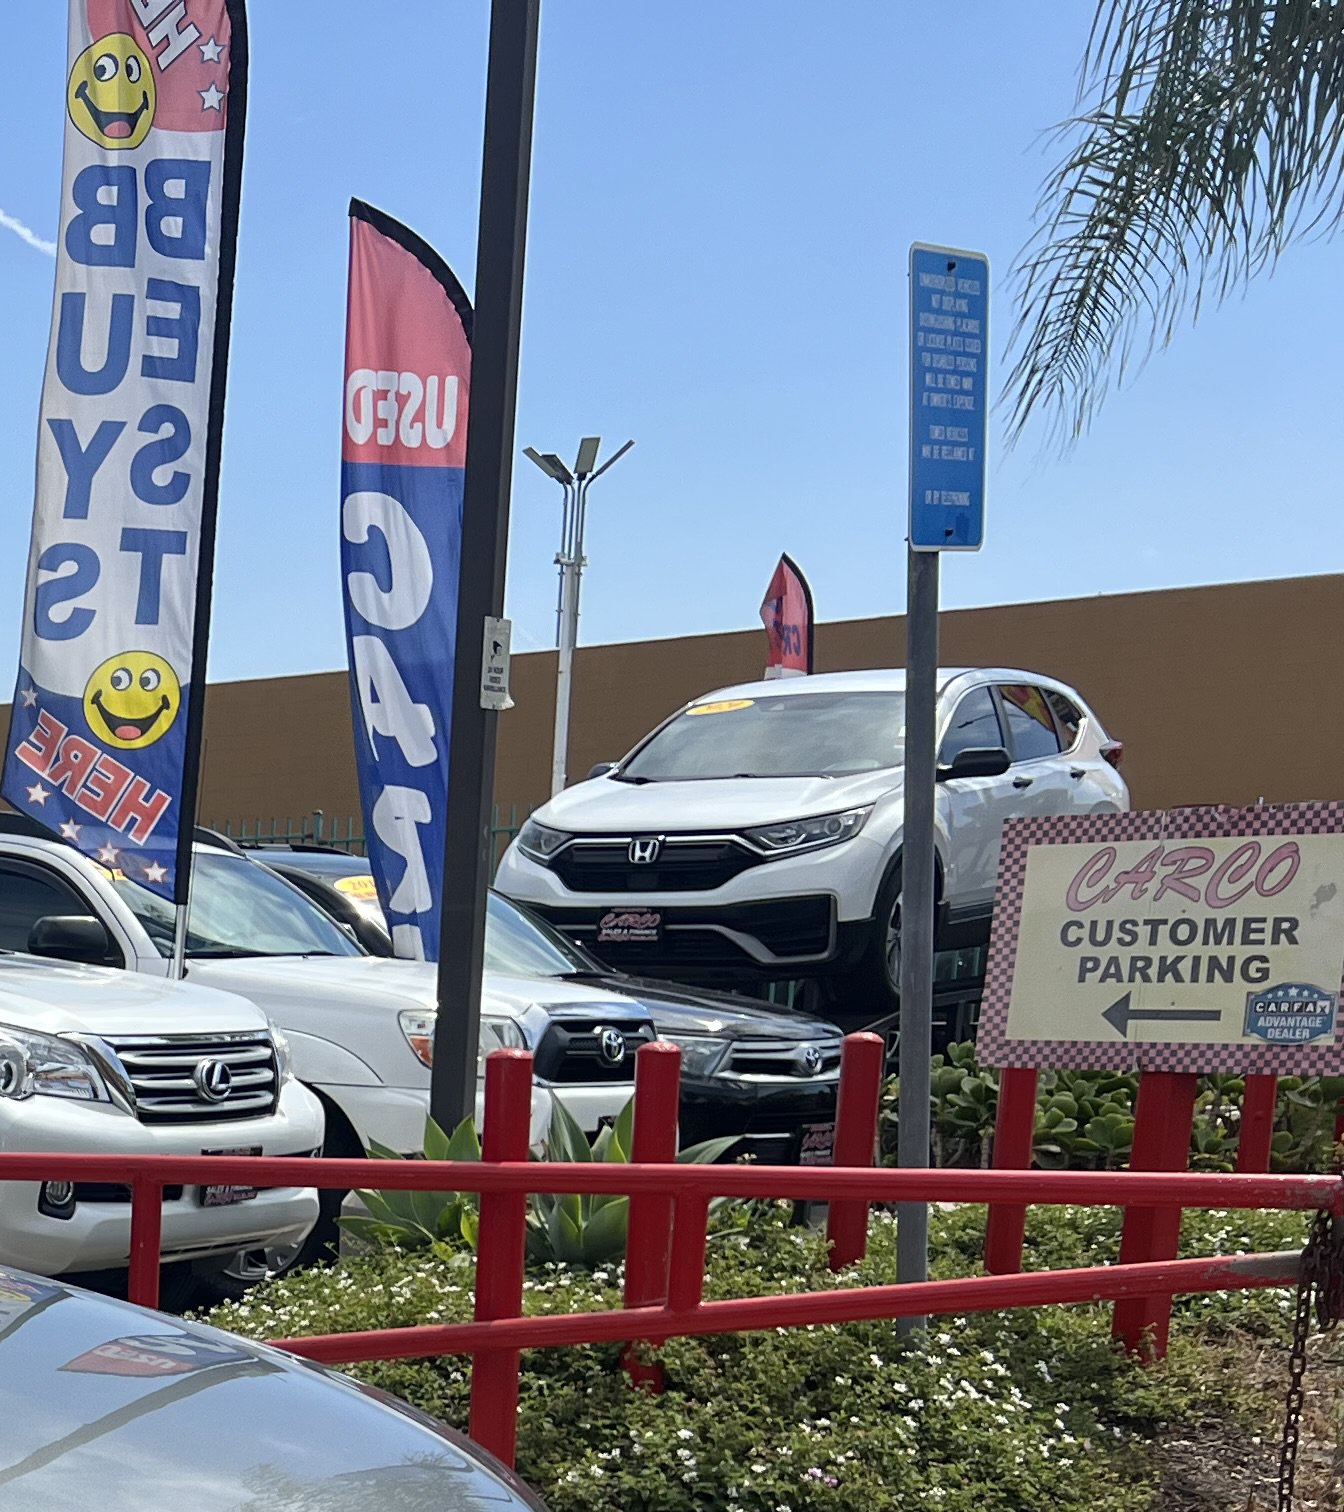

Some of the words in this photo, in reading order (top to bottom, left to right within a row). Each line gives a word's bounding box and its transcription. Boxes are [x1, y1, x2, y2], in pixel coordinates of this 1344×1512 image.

[1065, 841, 1301, 912] CARCO
[1059, 916, 1301, 949] CUSTOMER
[1076, 954, 1271, 985] PARKING
[1254, 1000, 1331, 1015] CARFAX
[1257, 1015, 1323, 1028] ADVANTAGE
[1267, 1028, 1310, 1040] DEALER
